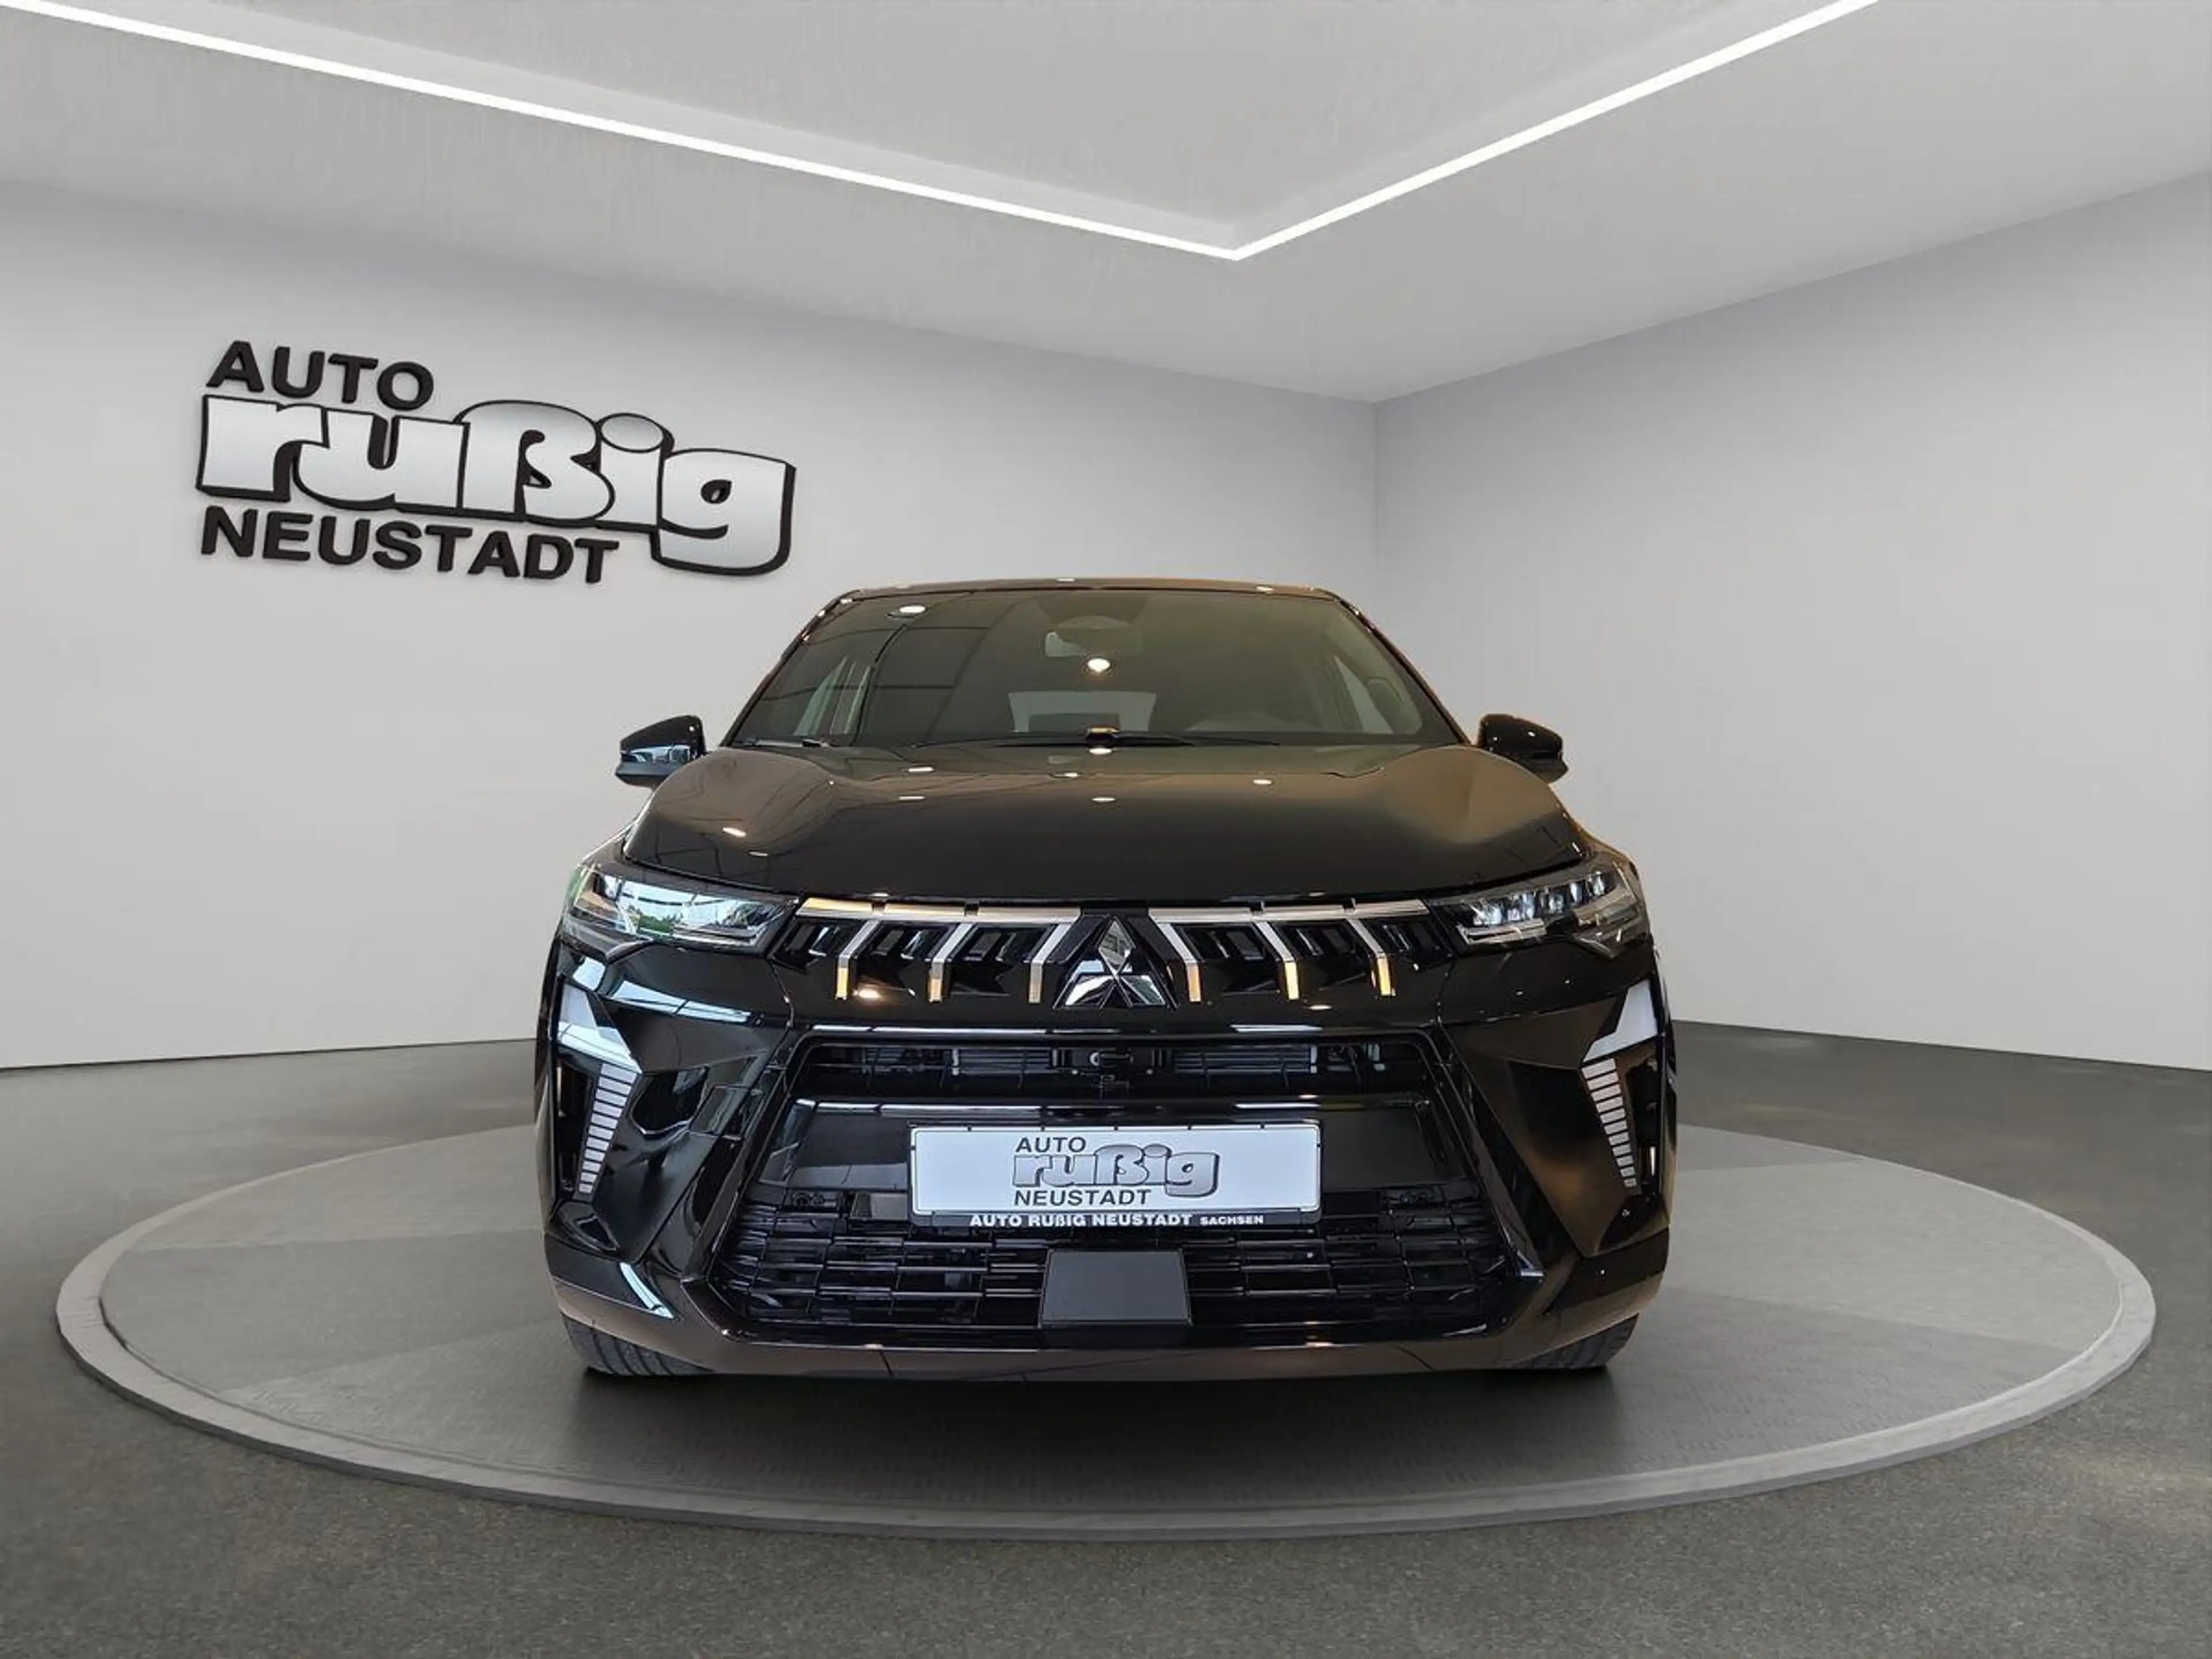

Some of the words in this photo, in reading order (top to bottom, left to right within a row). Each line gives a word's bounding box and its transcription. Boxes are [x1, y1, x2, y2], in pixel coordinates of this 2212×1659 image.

[206, 340, 434, 411] AUTO
[200, 505, 620, 584] NEUSTADT
[1015, 1137, 1087, 1153] AUTO
[1014, 1189, 1152, 1207] NEUSTADT
[969, 1214, 1022, 1228] AUTO
[1093, 1214, 1192, 1226] NEUSTADT
[1199, 1215, 1264, 1226] SACHSEN
